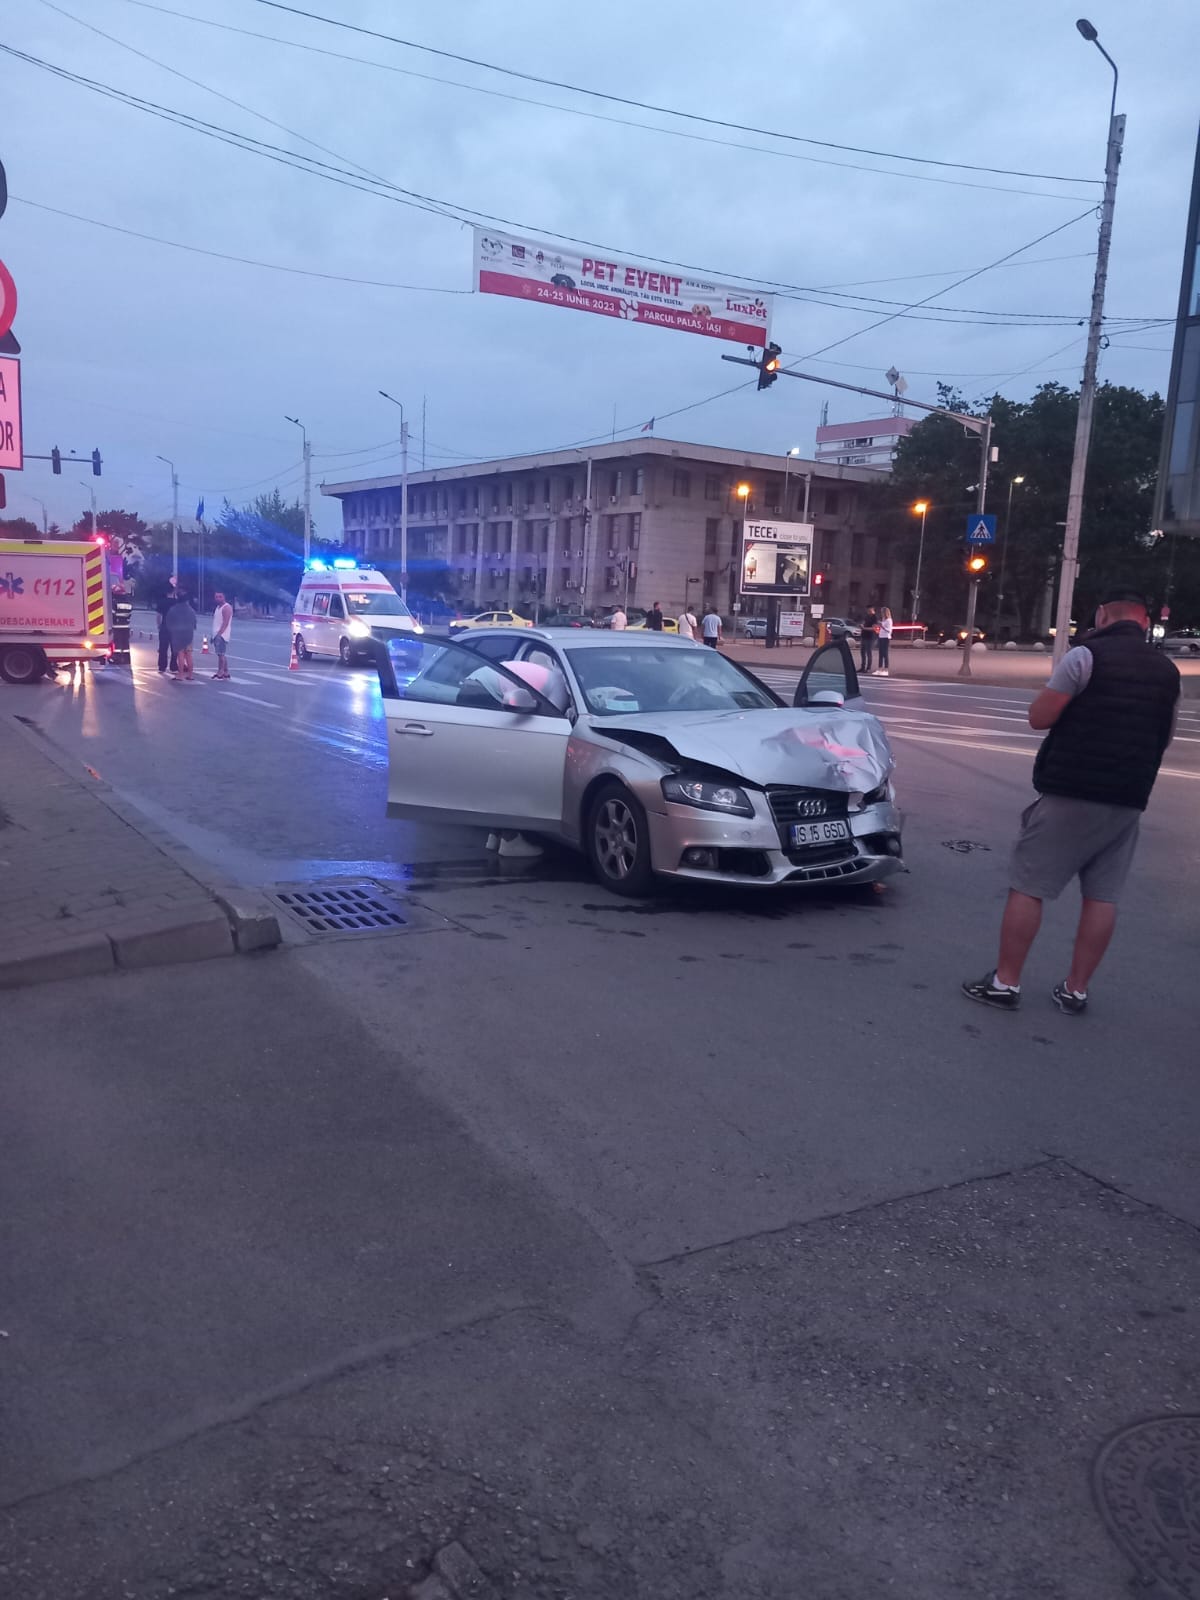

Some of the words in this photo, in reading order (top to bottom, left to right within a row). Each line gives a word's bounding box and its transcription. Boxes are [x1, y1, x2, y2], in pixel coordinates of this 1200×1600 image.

[582, 258, 618, 283] PET
[624, 267, 682, 297] EVENT
[537, 287, 564, 301] 24-25
[566, 294, 591, 307] IUNIE
[592, 299, 615, 312] 2023
[726, 298, 768, 319] LuxPet
[643, 310, 675, 325] PARCUL
[676, 317, 705, 331] PALAS,
[41, 578, 76, 596] 112
[809, 825, 820, 841] 15
[823, 823, 846, 838] GSD
